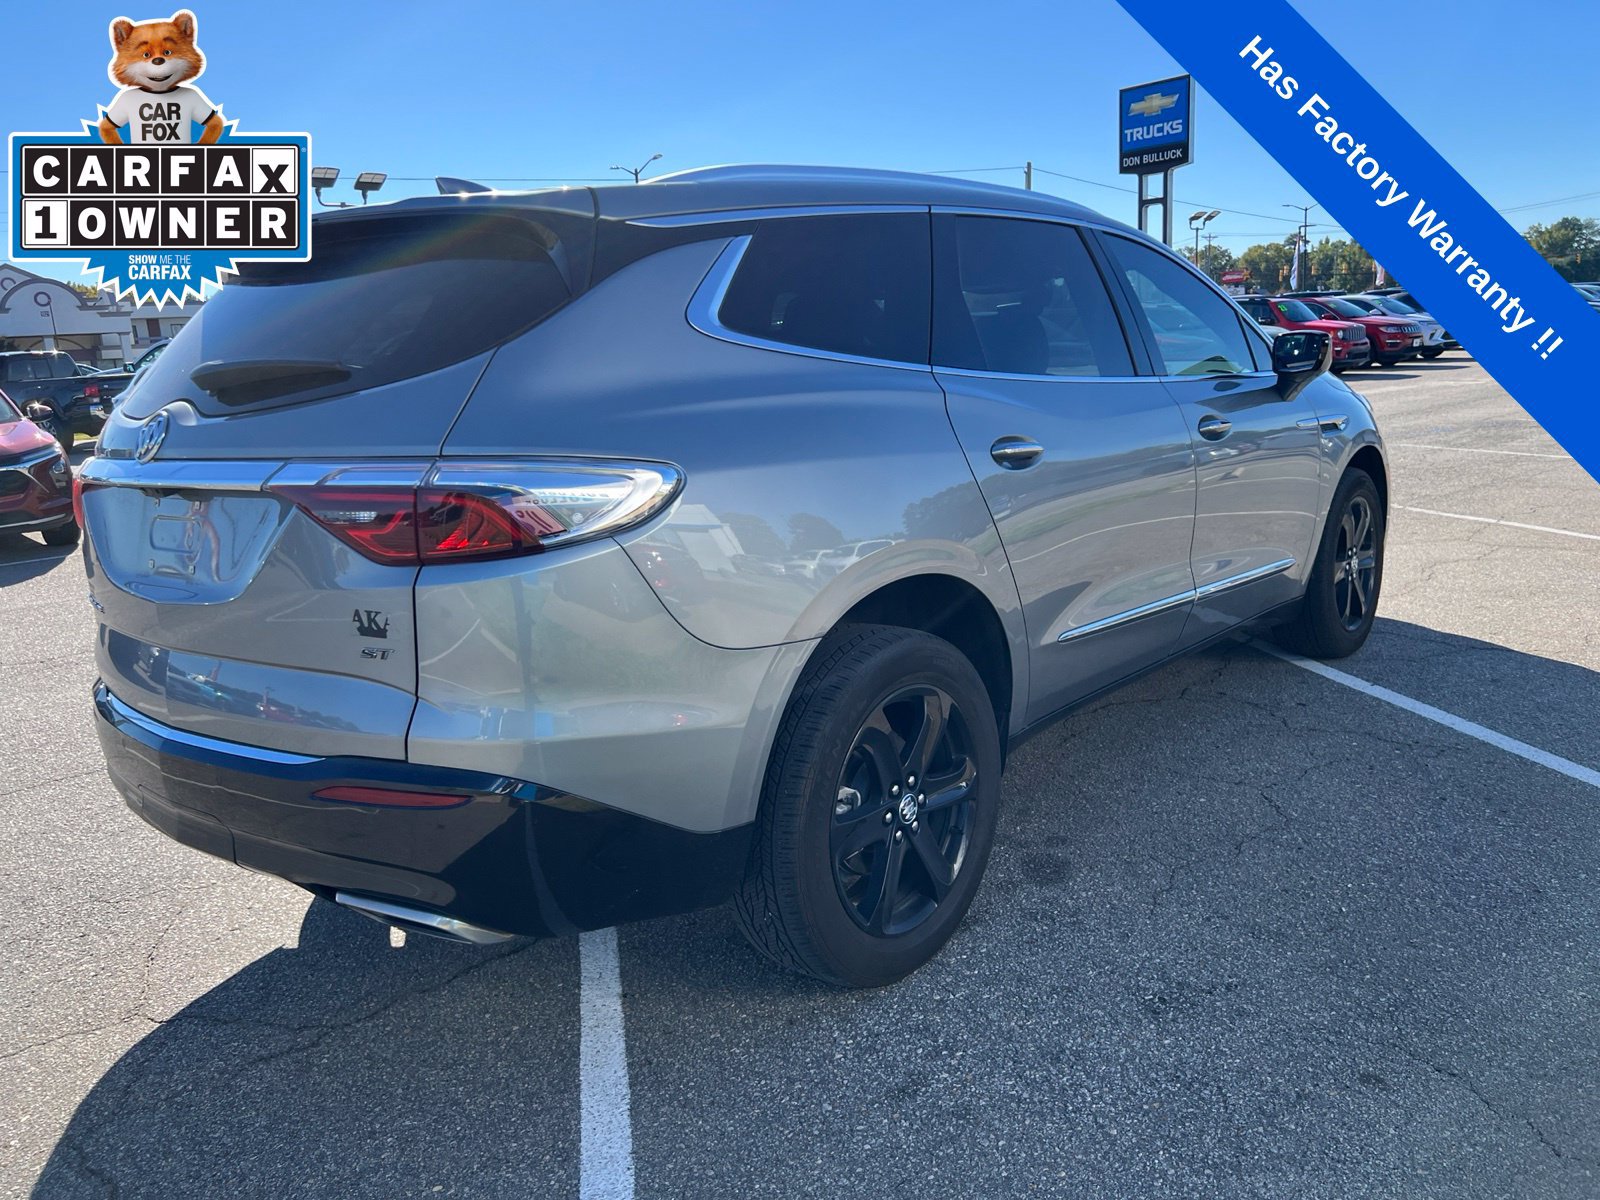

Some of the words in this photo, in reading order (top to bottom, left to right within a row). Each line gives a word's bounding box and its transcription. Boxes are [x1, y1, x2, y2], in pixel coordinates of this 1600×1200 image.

[1124, 119, 1183, 143] TRUCKS
[1122, 156, 1140, 168] DON
[1142, 148, 1183, 164] BULLUCK
[360, 647, 396, 661] ST
